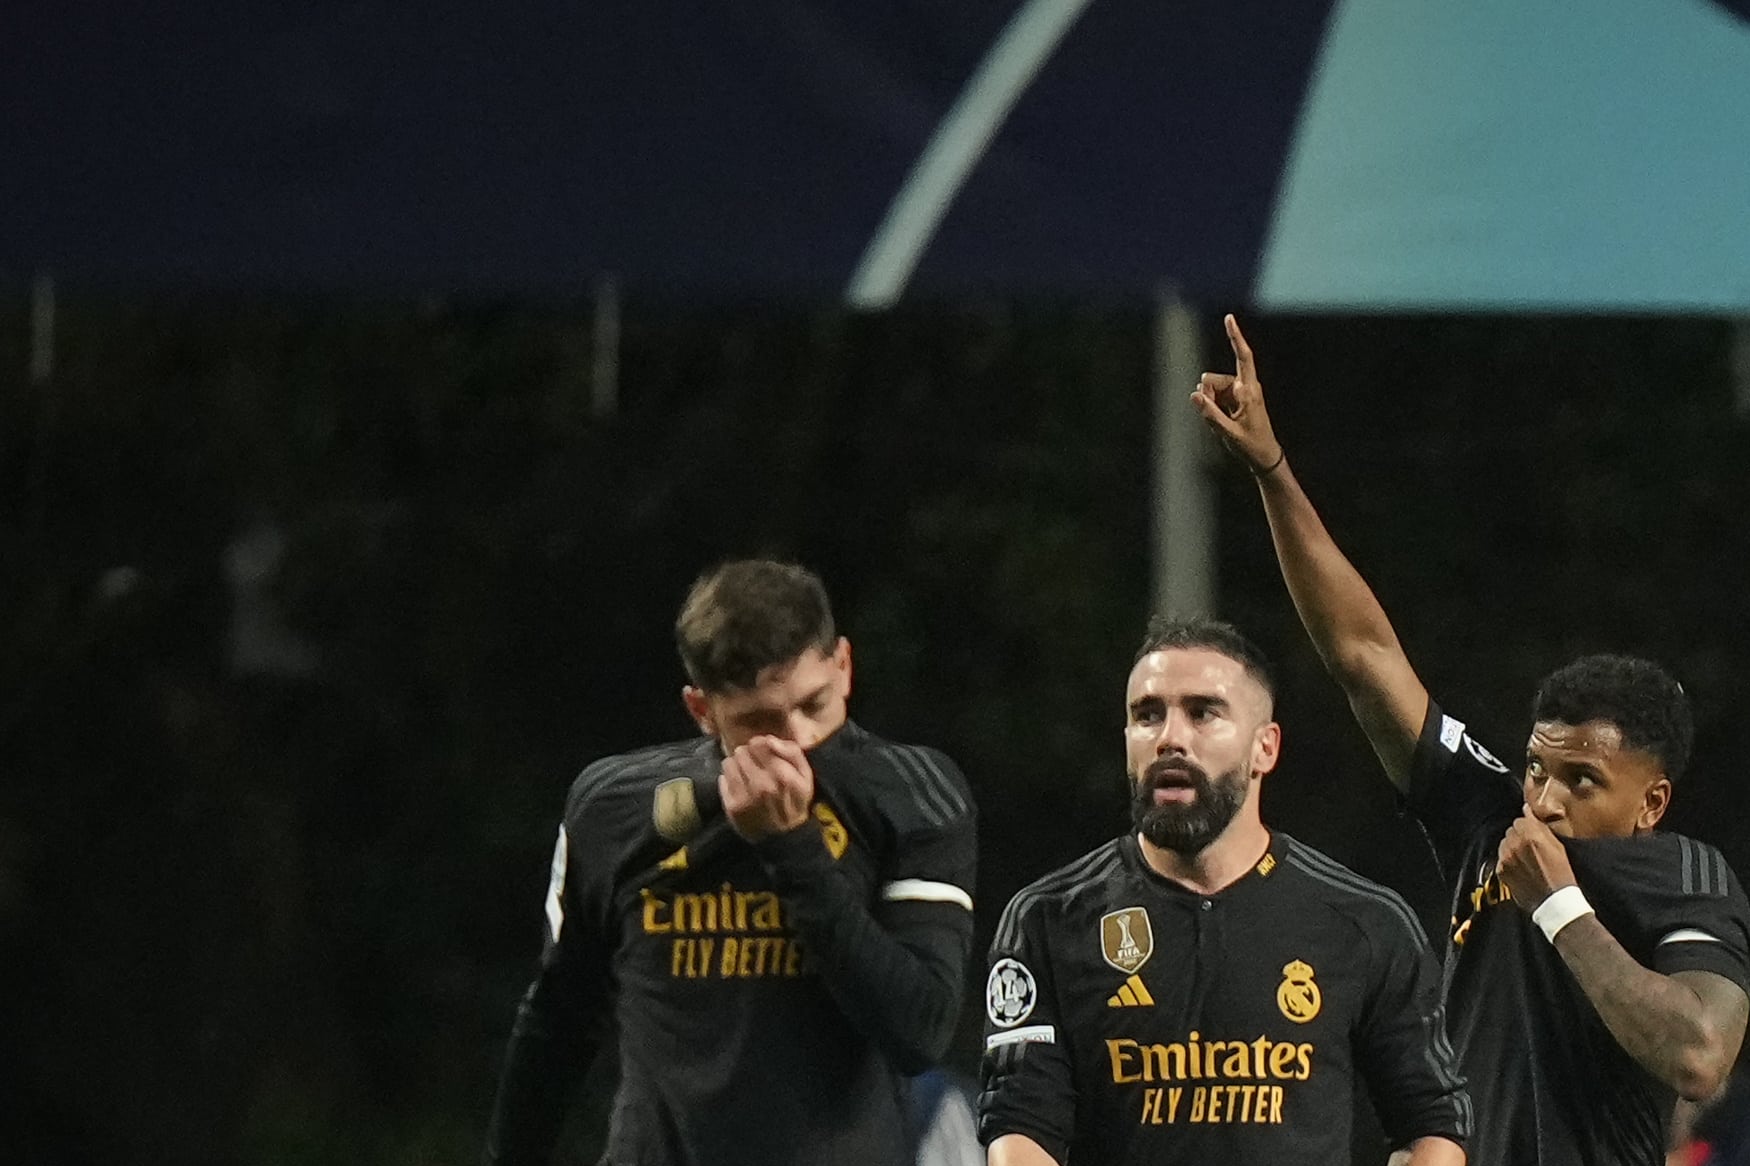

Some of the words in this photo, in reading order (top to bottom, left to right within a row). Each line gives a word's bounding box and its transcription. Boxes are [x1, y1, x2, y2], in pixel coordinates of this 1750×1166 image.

[672, 937, 715, 979] FLY
[1105, 1030, 1314, 1084] Emirates
[1140, 1086, 1183, 1125] FLY
[1189, 1085, 1283, 1124] BETTER
